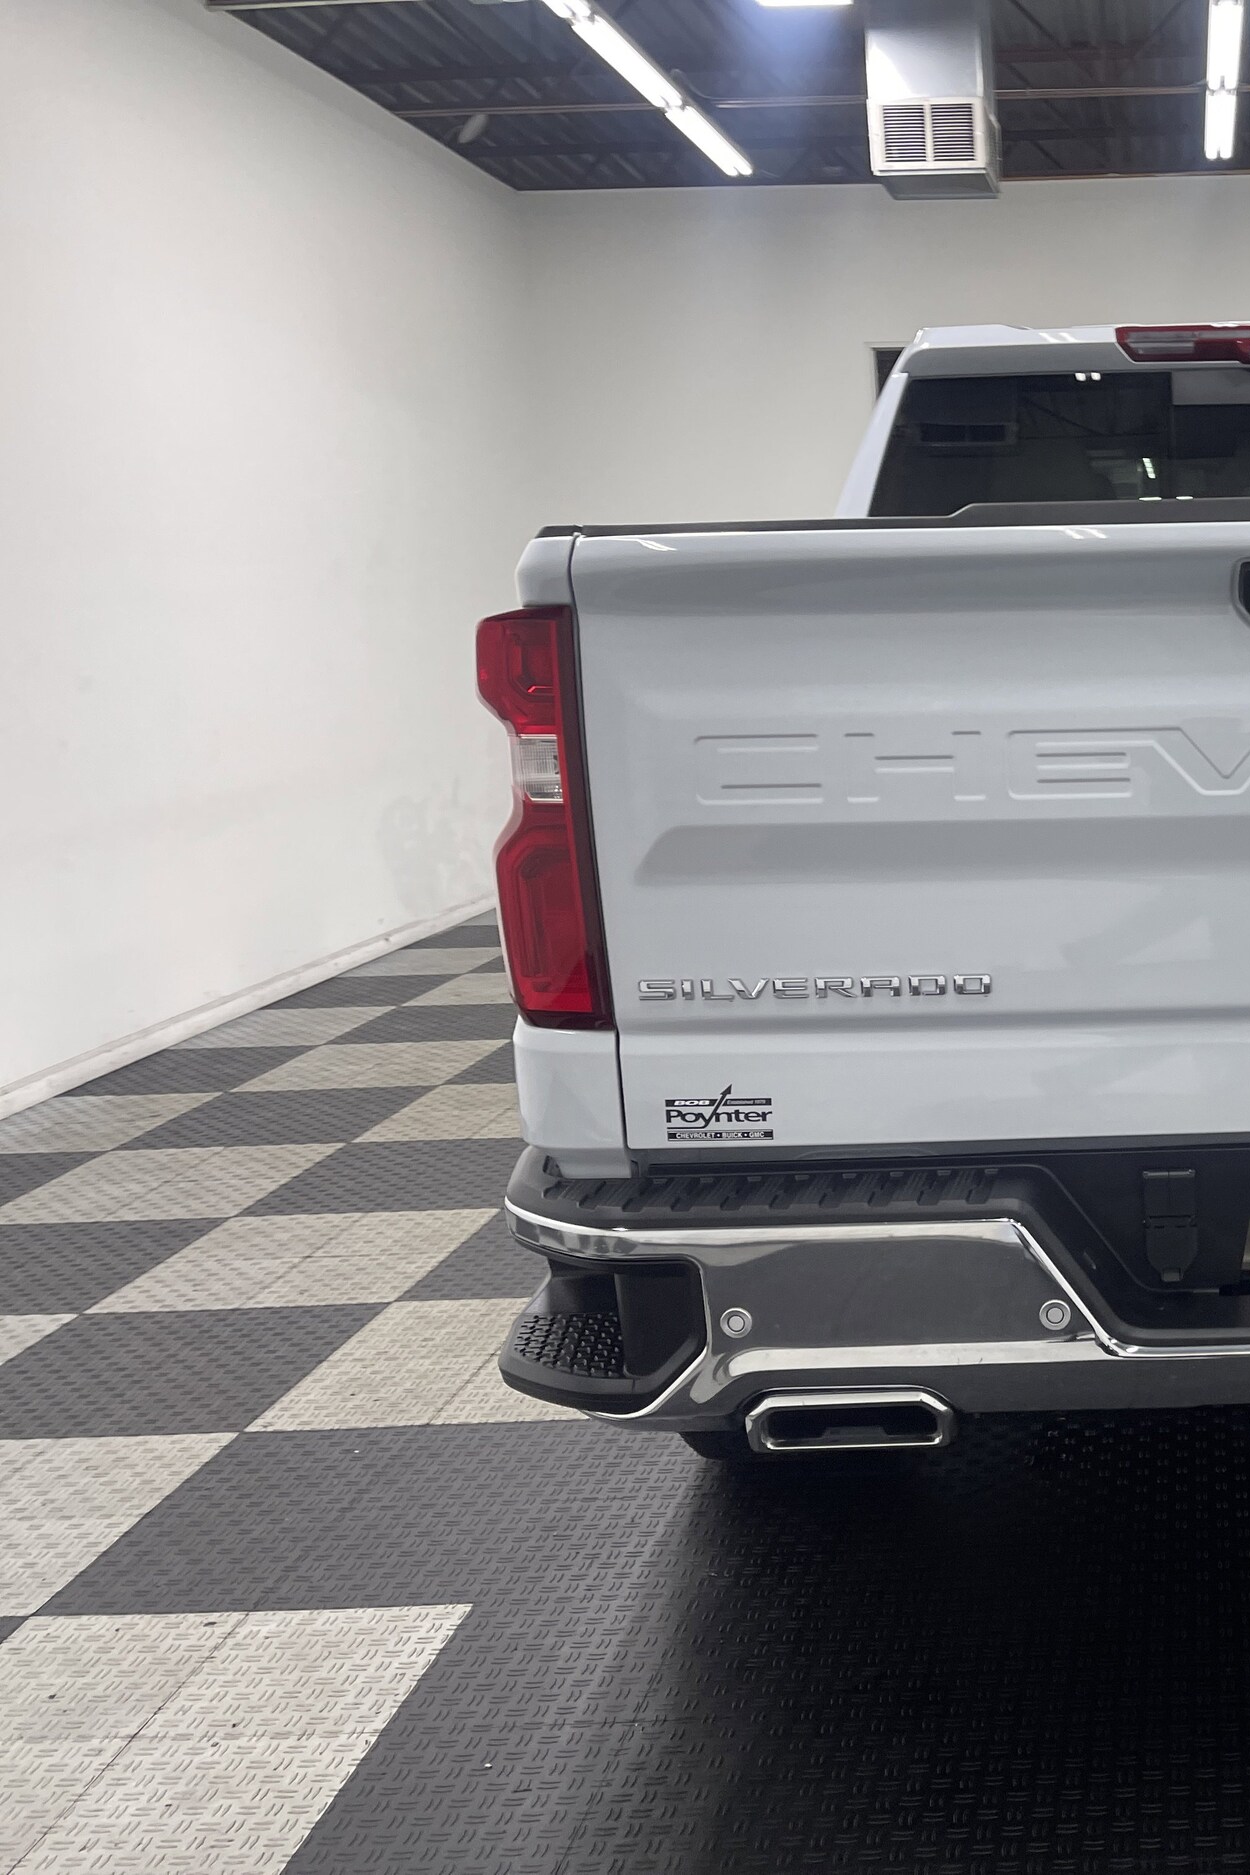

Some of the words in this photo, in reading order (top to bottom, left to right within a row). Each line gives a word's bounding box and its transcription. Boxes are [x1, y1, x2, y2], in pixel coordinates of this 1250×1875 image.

[638, 973, 992, 1001] SILVERADO
[665, 1108, 773, 1129] Poynter
[722, 1131, 743, 1139] BUICK
